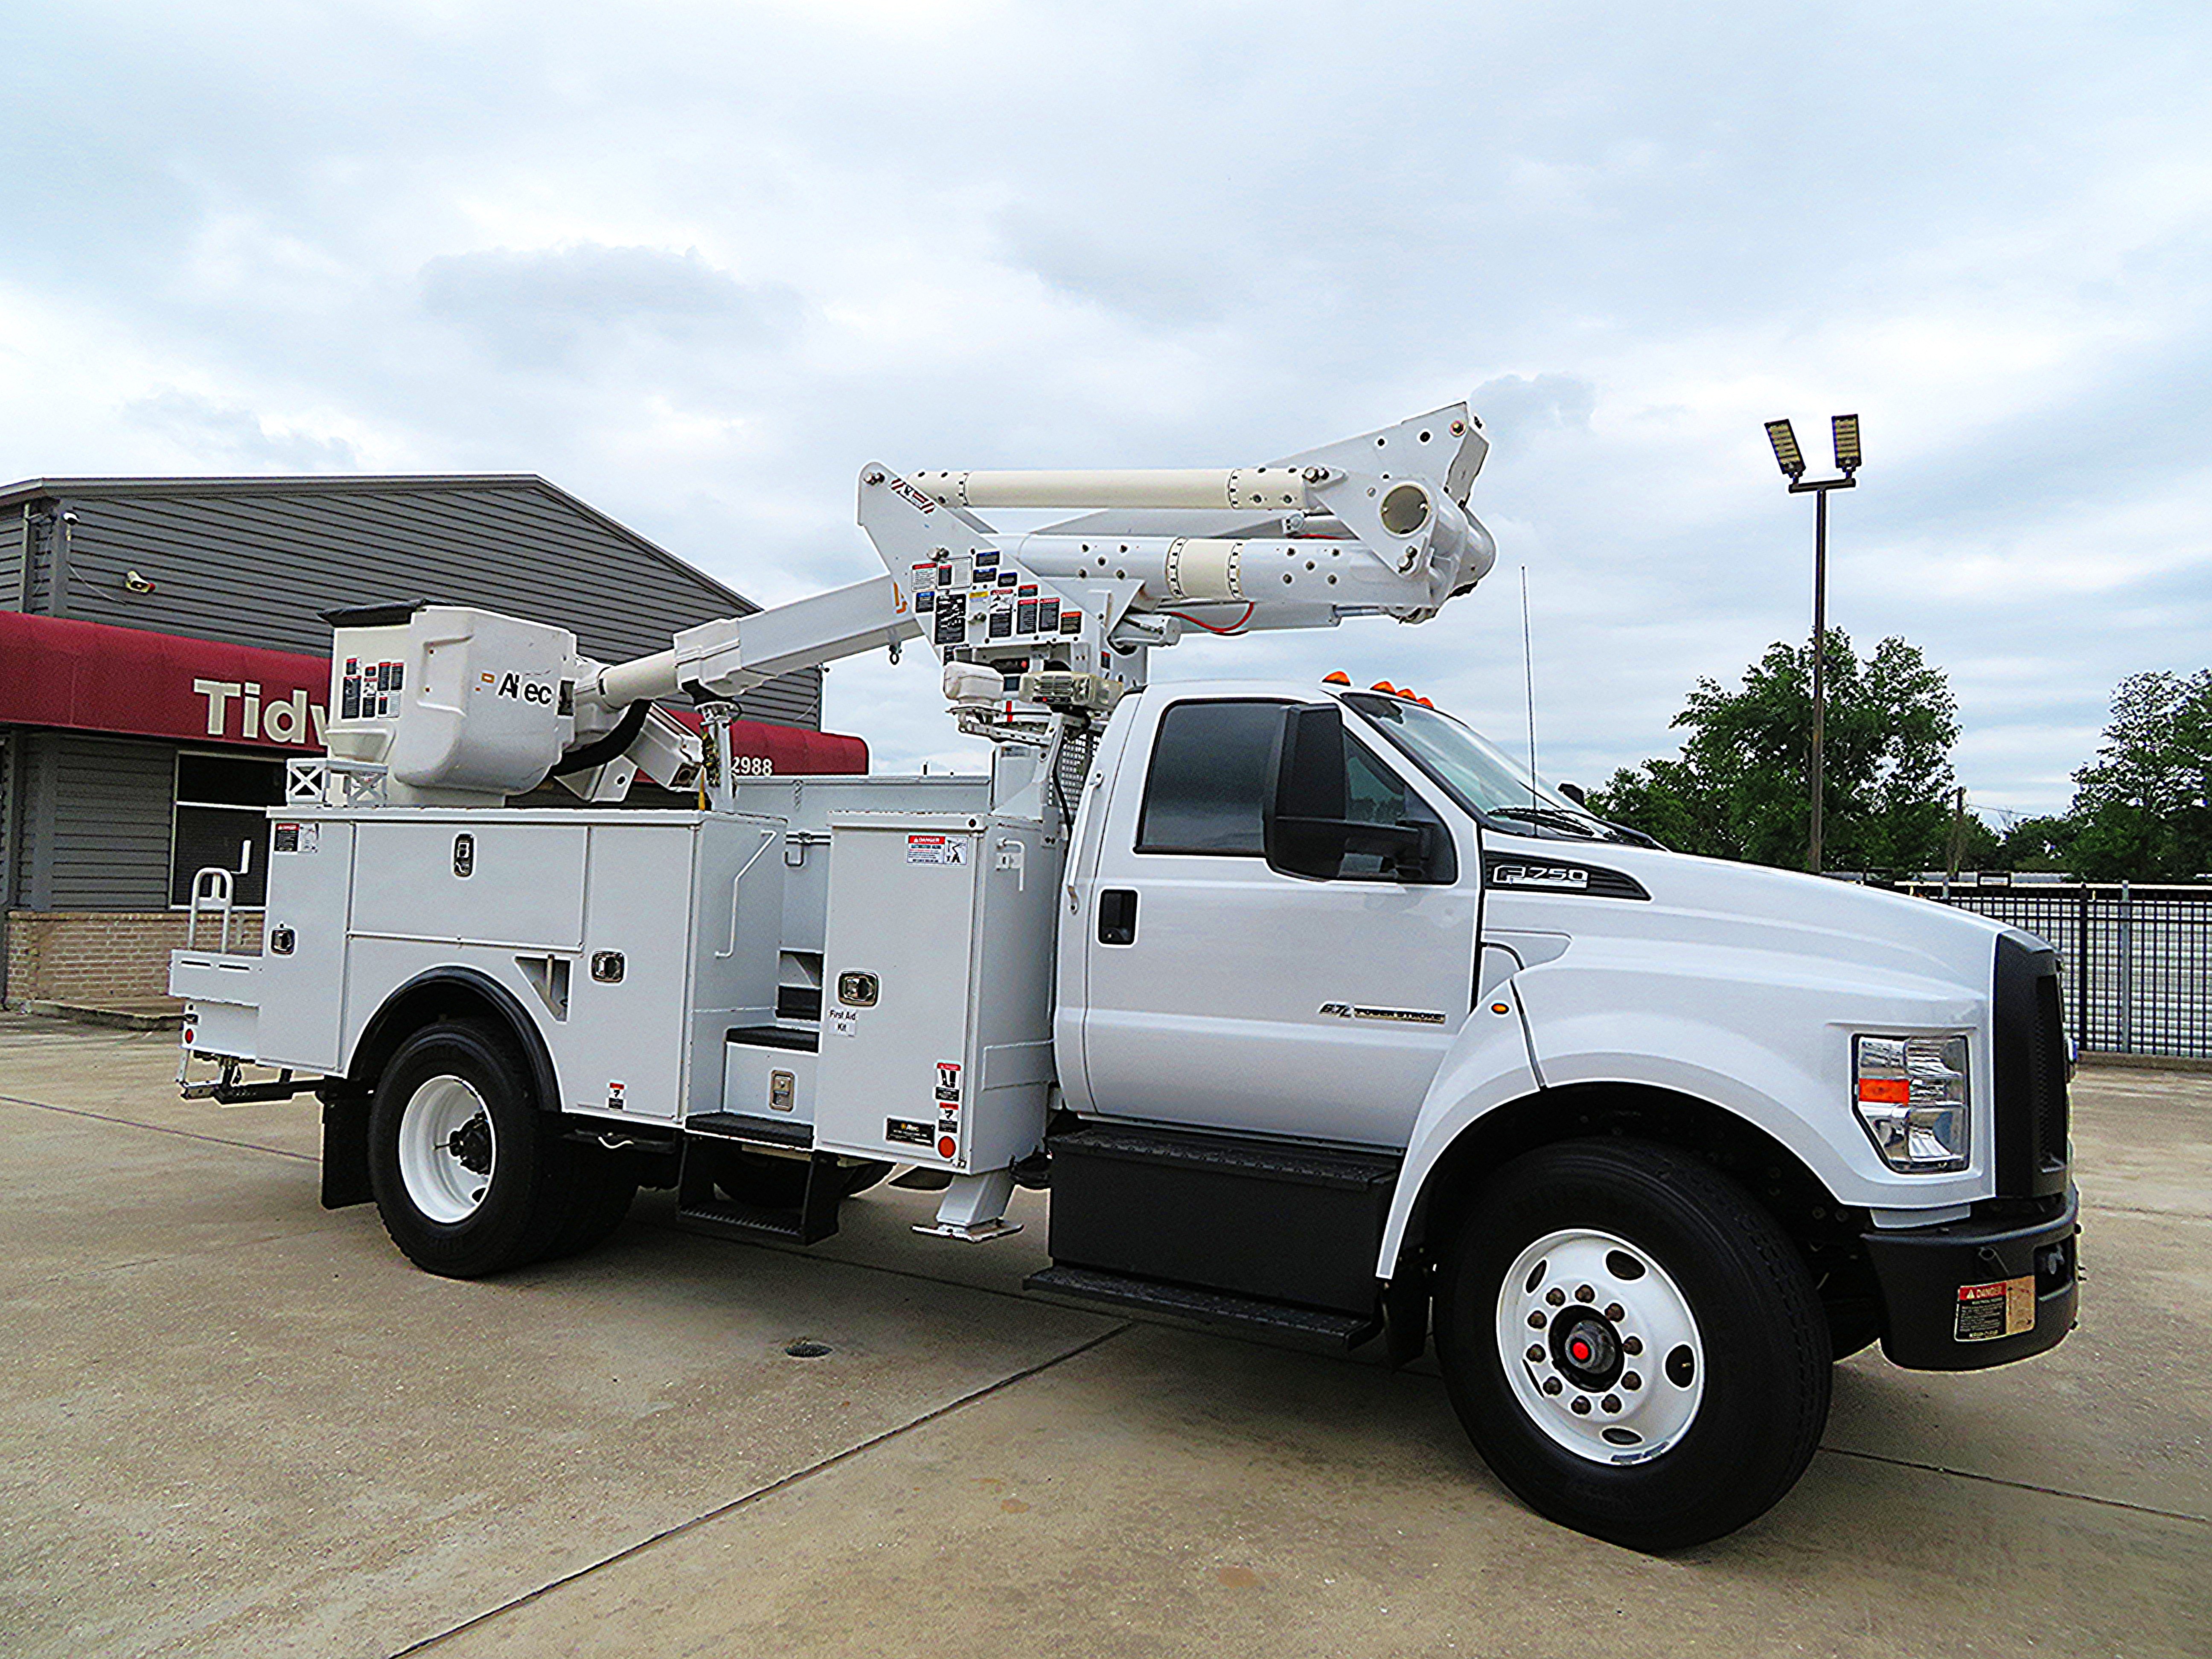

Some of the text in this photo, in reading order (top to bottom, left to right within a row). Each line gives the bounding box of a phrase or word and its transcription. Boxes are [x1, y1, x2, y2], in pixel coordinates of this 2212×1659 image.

[731, 756, 772, 777] 2988
[830, 1010, 856, 1020] First Aid
[838, 1023, 847, 1032] Kit
[1976, 1286, 2002, 1298] DANGER
